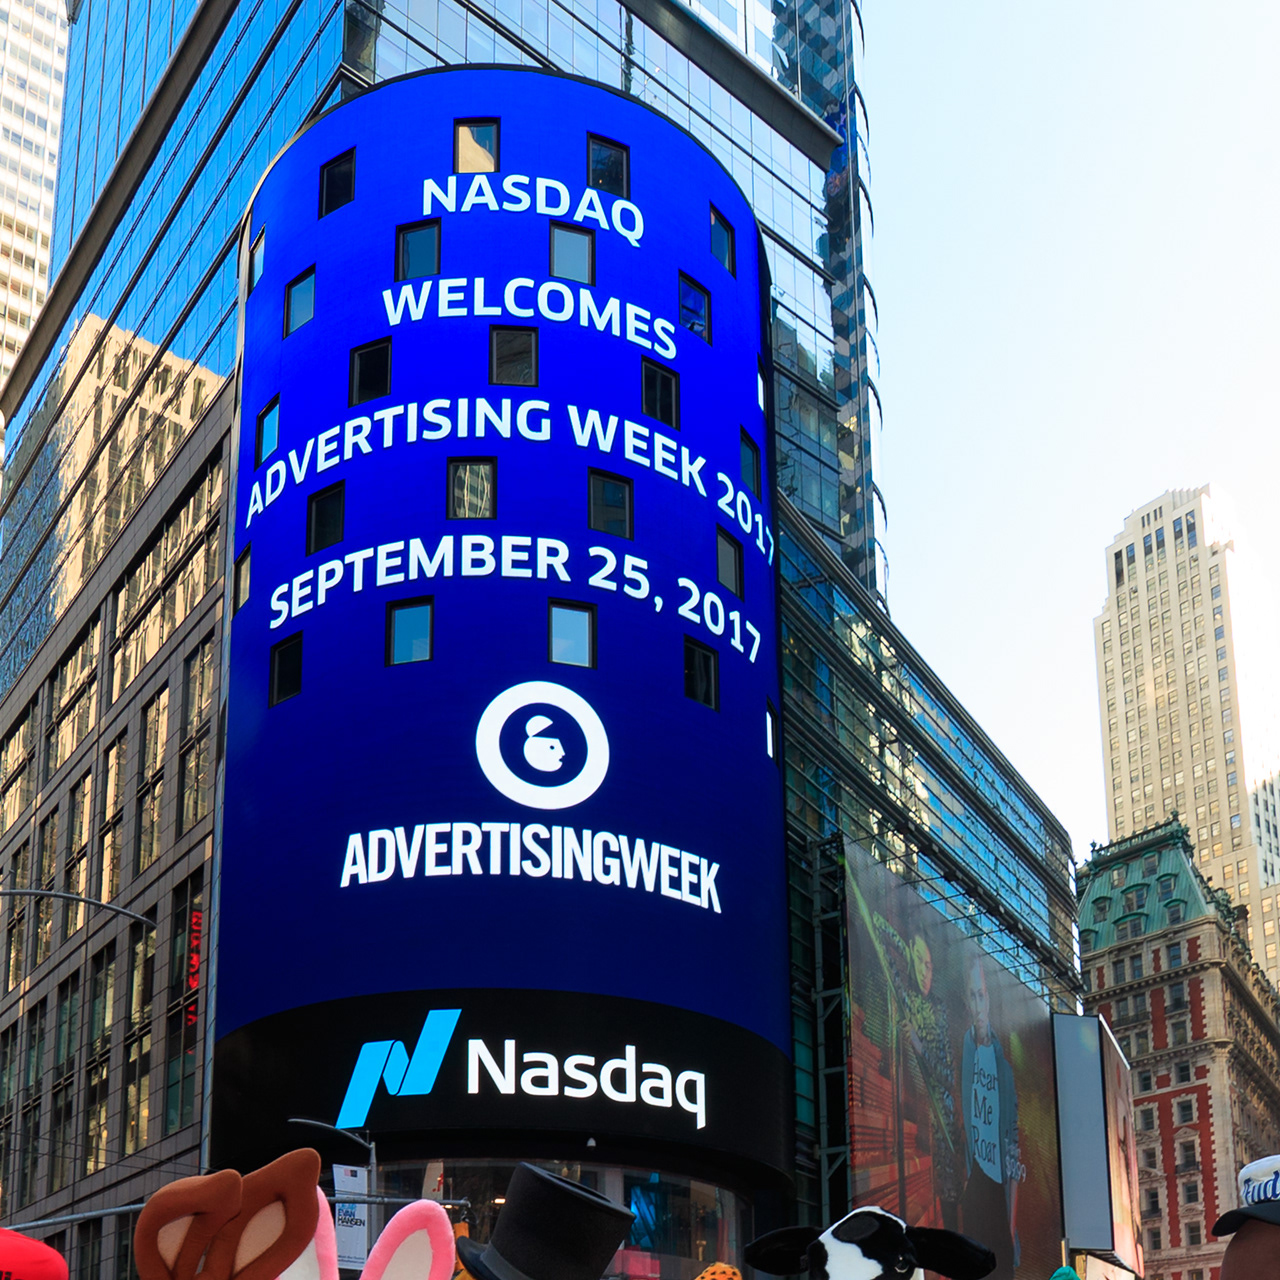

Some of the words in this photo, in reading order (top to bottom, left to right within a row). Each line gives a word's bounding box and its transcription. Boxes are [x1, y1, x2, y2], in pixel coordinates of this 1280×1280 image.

[422, 173, 645, 248] NASDAQ
[382, 276, 678, 360] WELCOMES
[245, 397, 552, 528] ADVERTISING
[567, 403, 708, 497] WEEK
[716, 471, 774, 566] 2017
[269, 534, 571, 630] SEPTEMBER
[588, 546, 665, 612] 25,
[678, 578, 761, 664] 2017
[340, 822, 722, 913] ADVERTISINGWEEK
[467, 1039, 707, 1129] Nasdaq
[973, 1088, 993, 1126] Me
